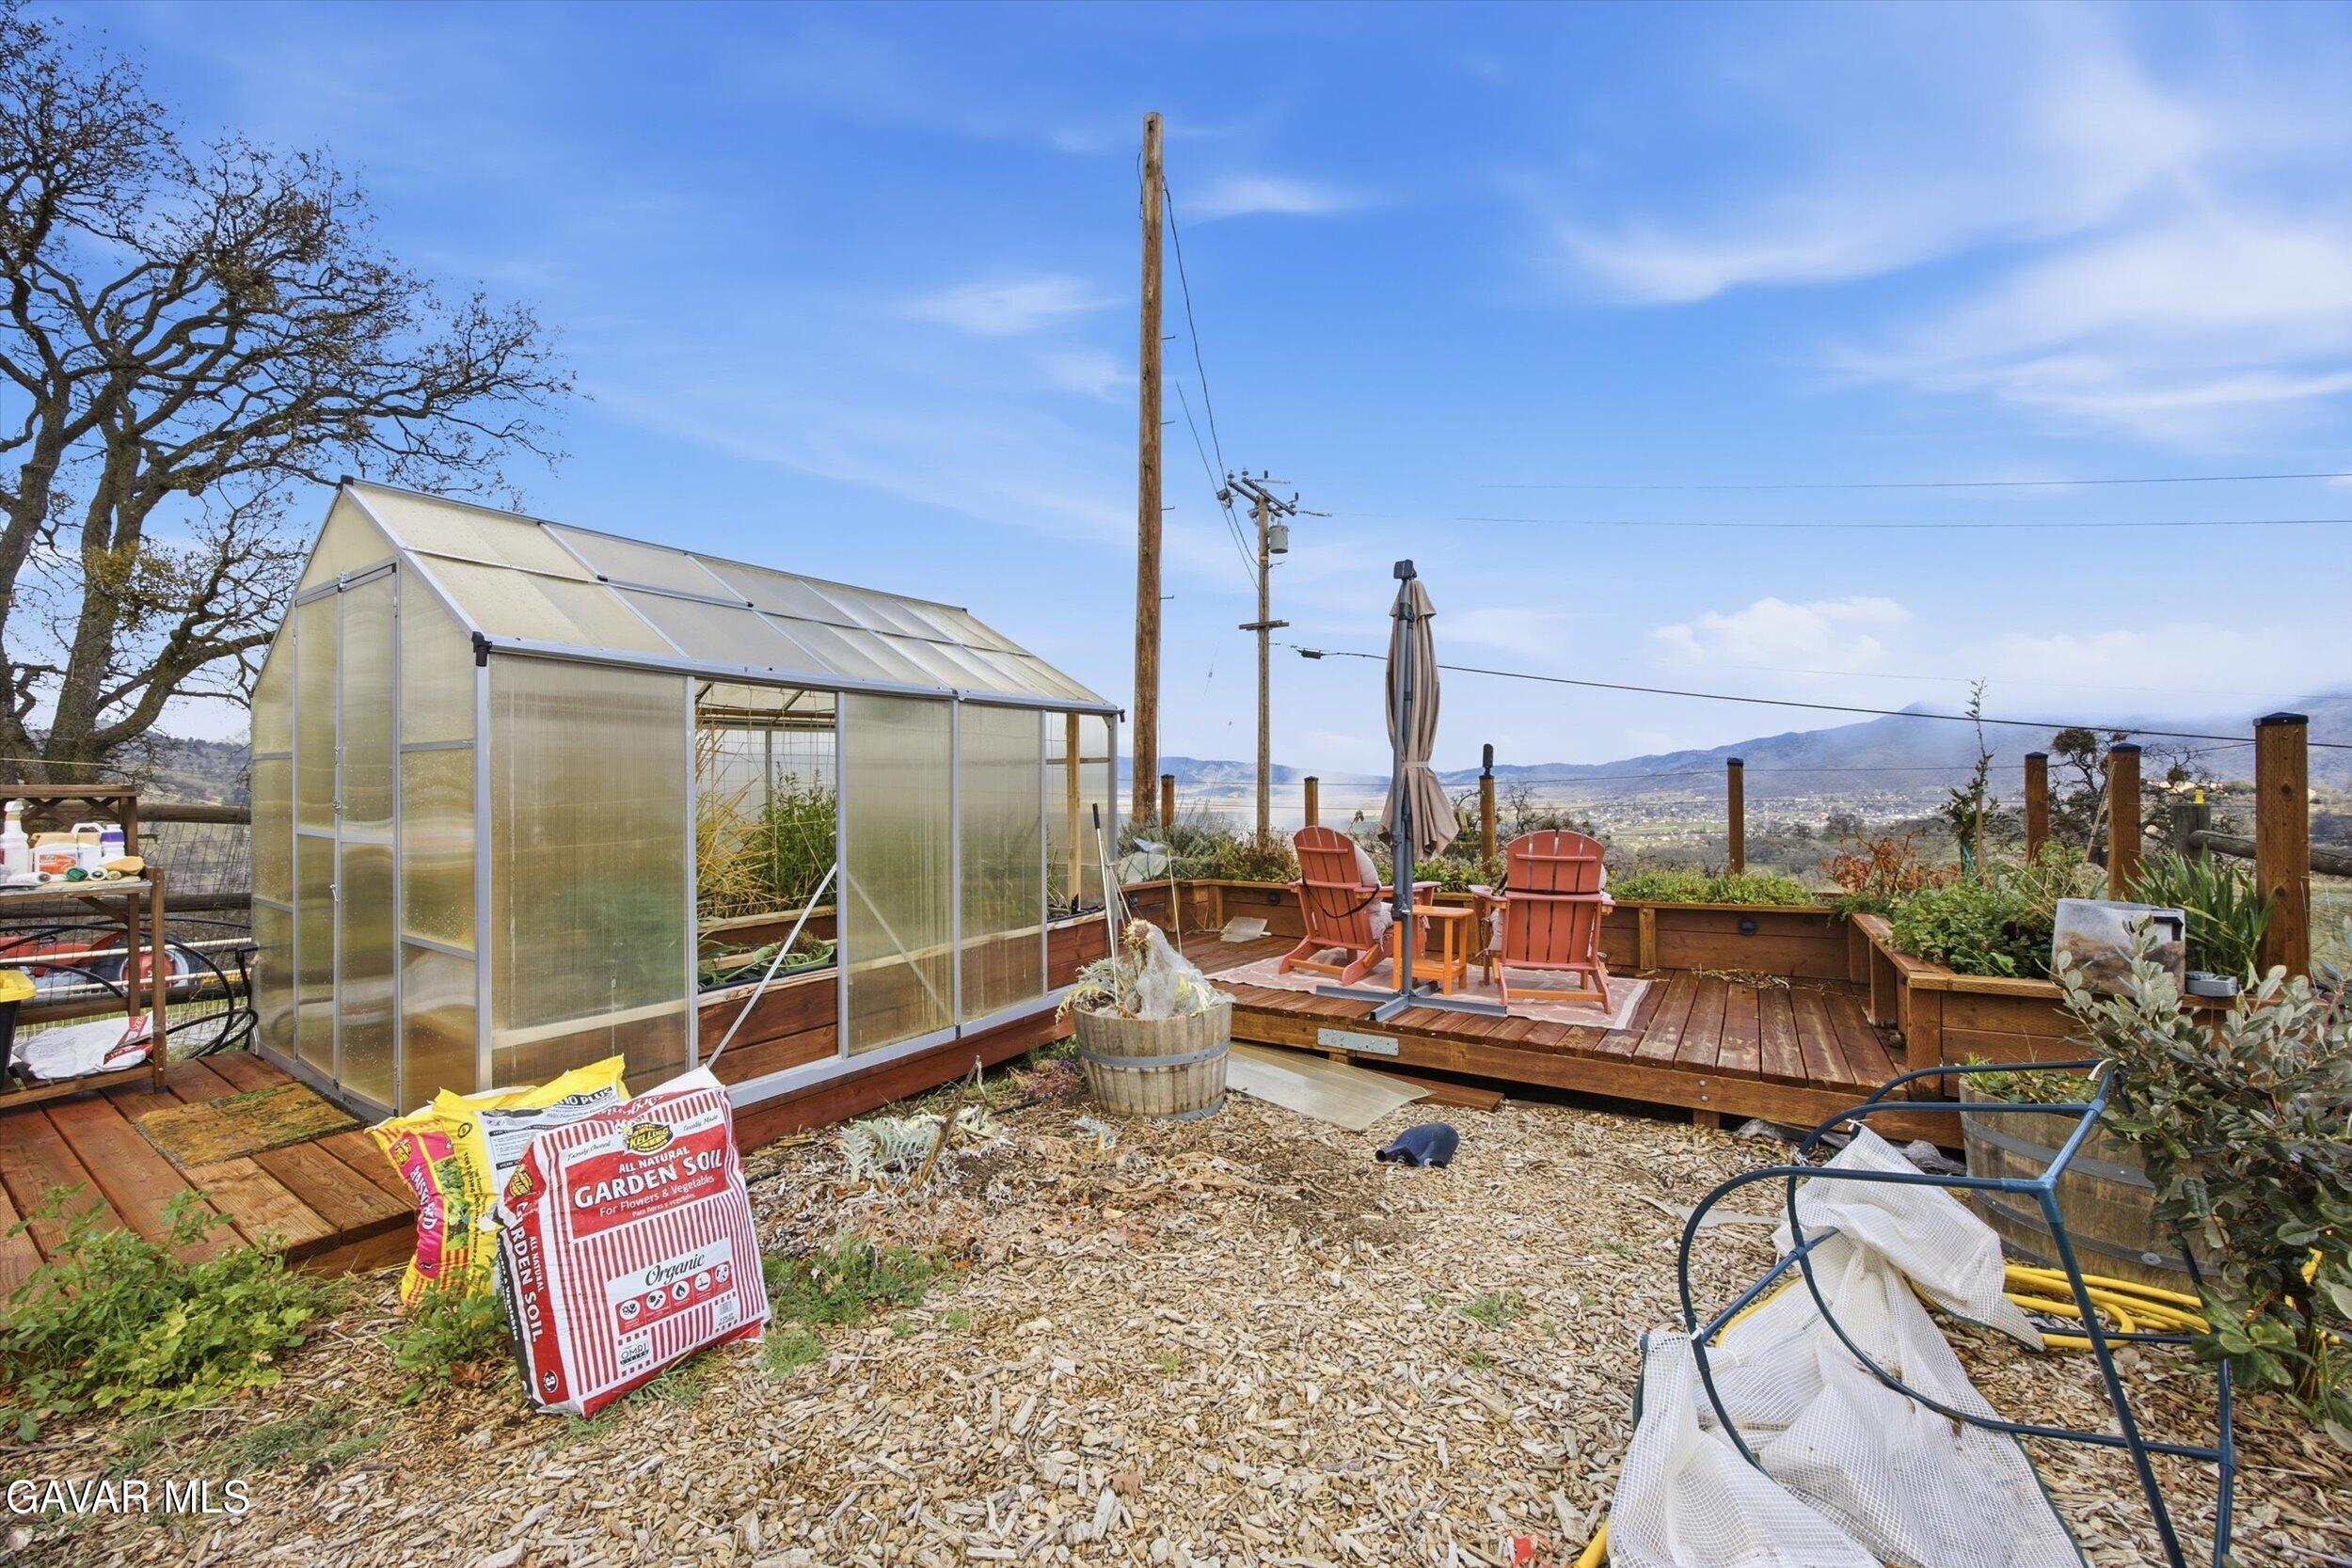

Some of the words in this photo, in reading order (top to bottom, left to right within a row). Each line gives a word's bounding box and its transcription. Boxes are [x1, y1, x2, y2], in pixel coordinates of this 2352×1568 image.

[574, 1164, 678, 1210] GARDEN
[682, 1148, 723, 1177] SOIL
[618, 1161, 637, 1174] ALL
[639, 1146, 690, 1167] NATURAL
[599, 1205, 617, 1217] For
[620, 1193, 660, 1212] Flowers
[661, 1188, 669, 1198] &
[671, 1175, 715, 1196] Vegetables
[529, 1236, 537, 1251] ALL
[531, 1253, 544, 1292] NATURAL
[644, 1253, 706, 1286] Organic
[524, 1291, 545, 1343] SOIL
